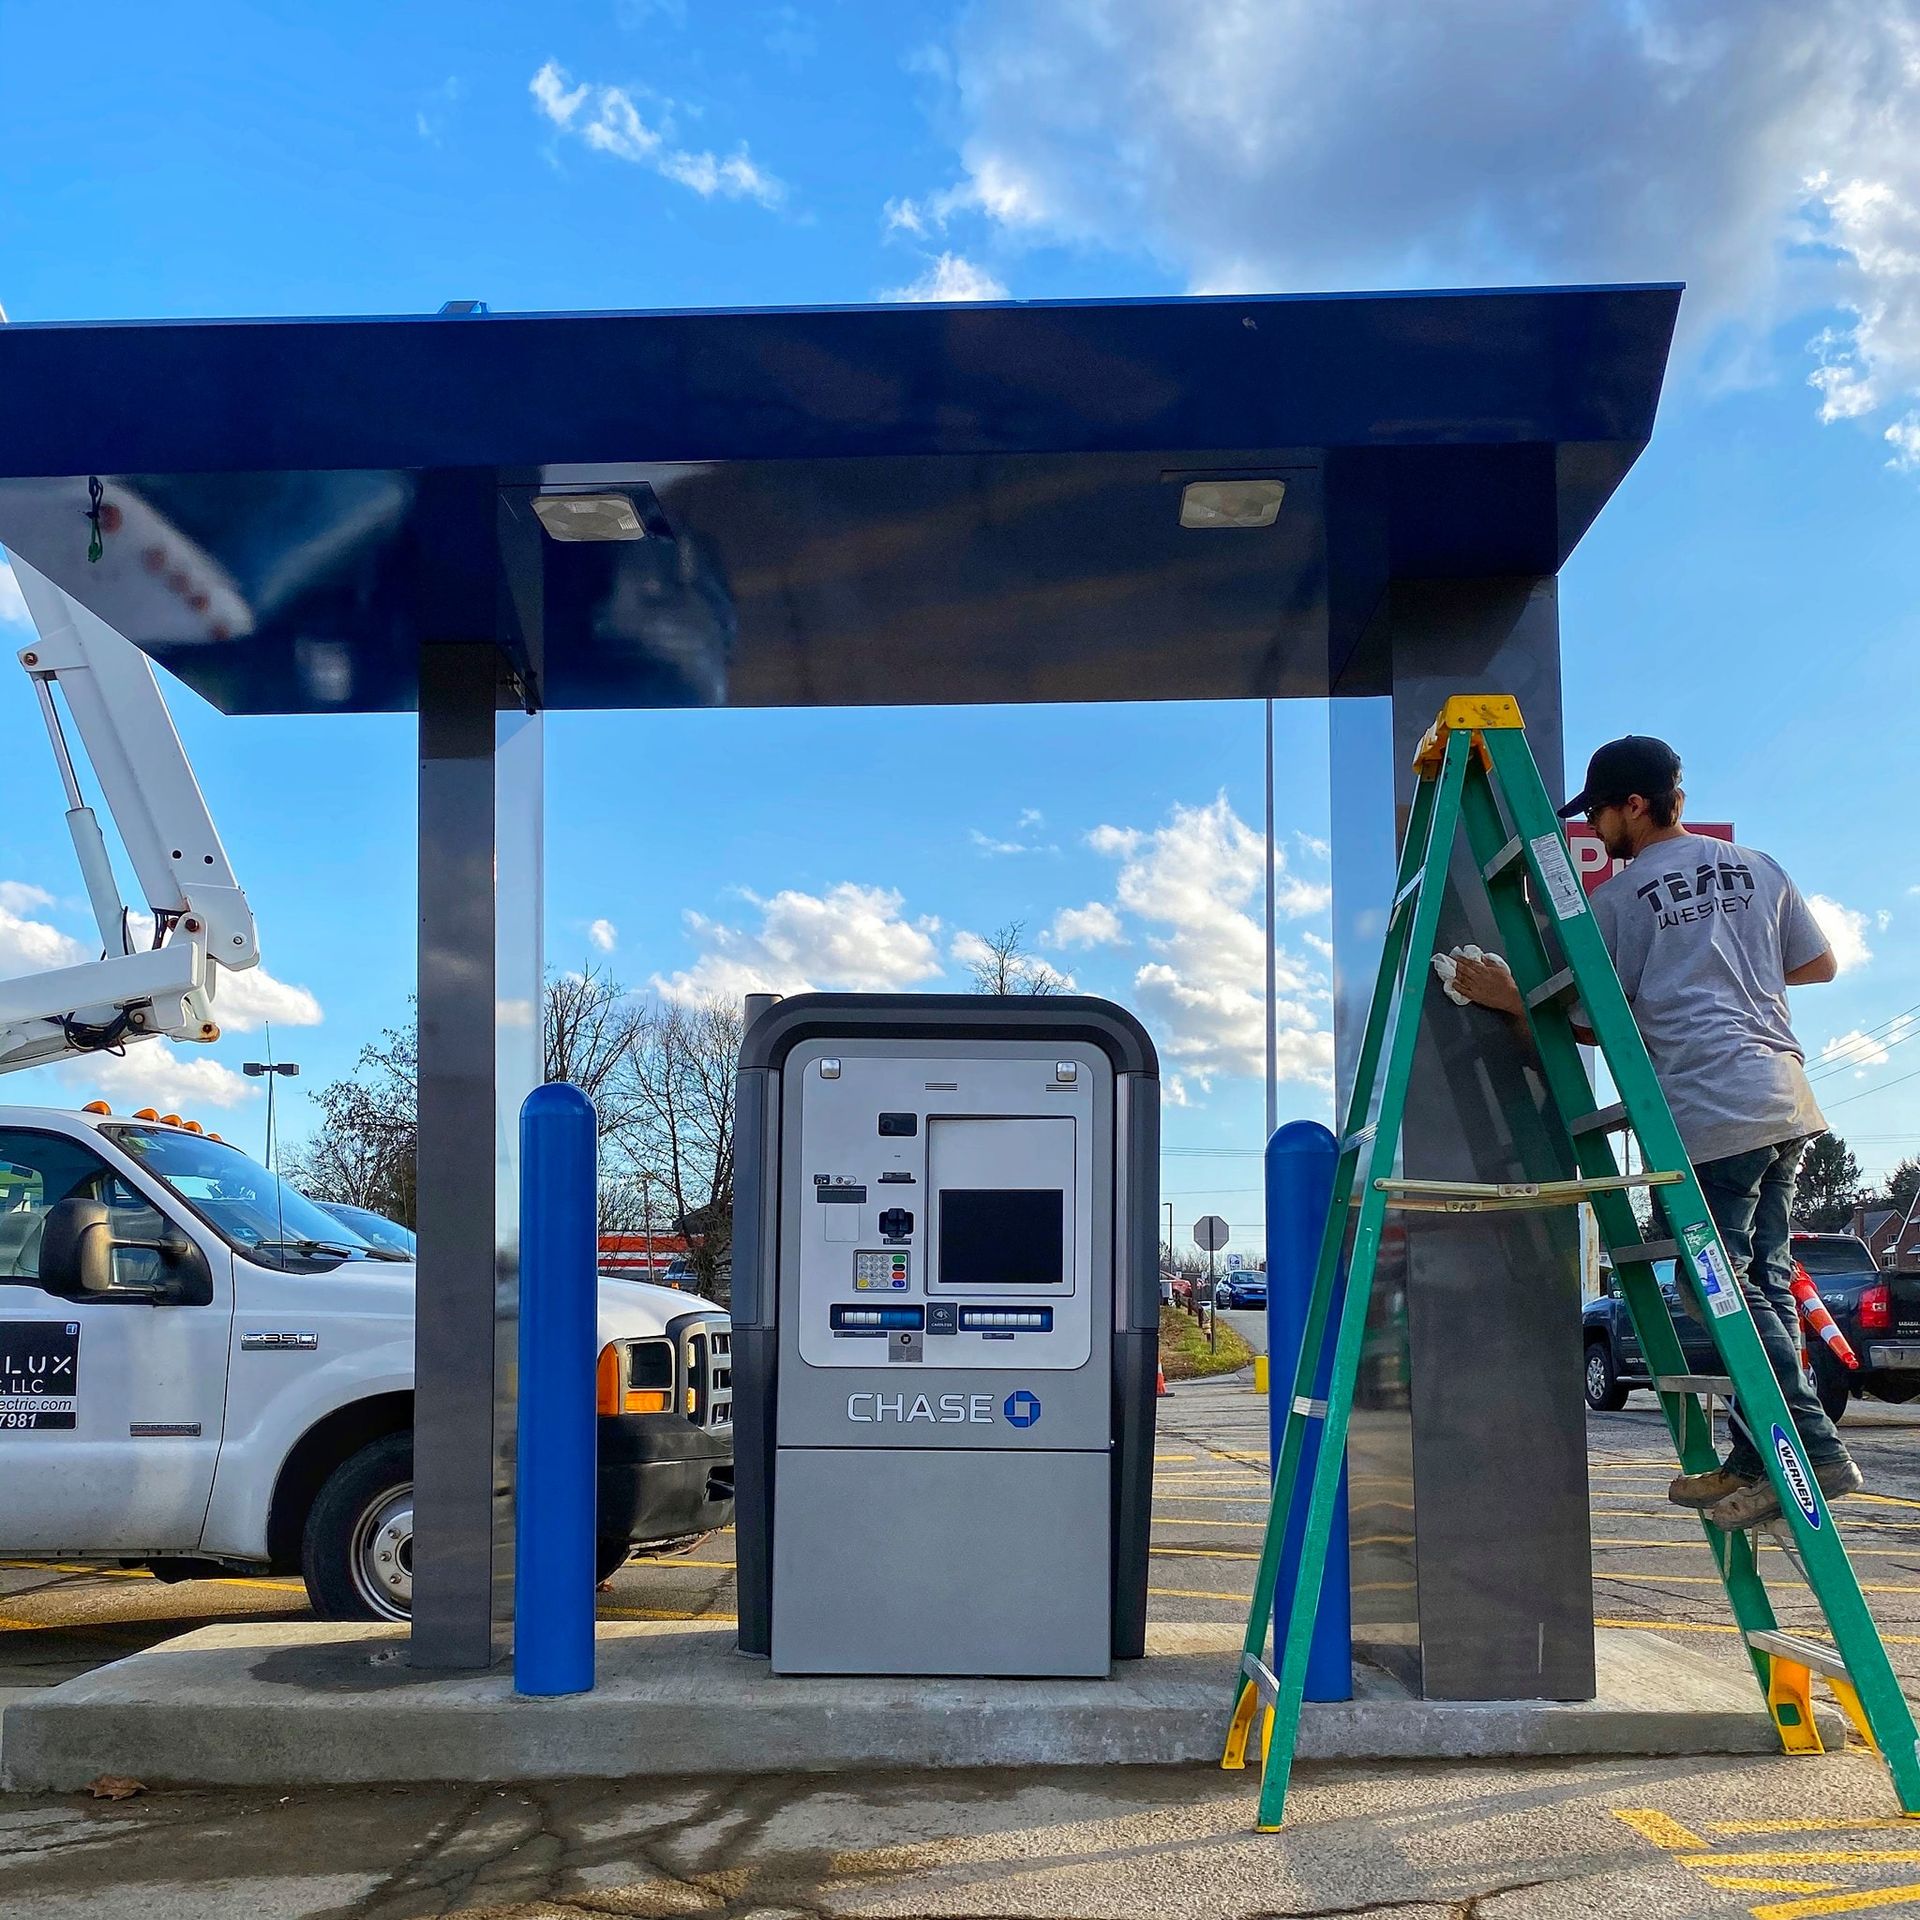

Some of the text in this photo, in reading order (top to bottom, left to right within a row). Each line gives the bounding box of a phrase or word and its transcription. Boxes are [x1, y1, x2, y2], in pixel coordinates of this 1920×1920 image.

[1637, 862, 1755, 913] TEAM
[5, 1355, 72, 1375] LUX
[12, 1379, 44, 1394] LLC
[0, 1413, 37, 1428] 7981
[846, 1392, 996, 1424] CHASE
[1780, 1444, 1813, 1509] WERNER
